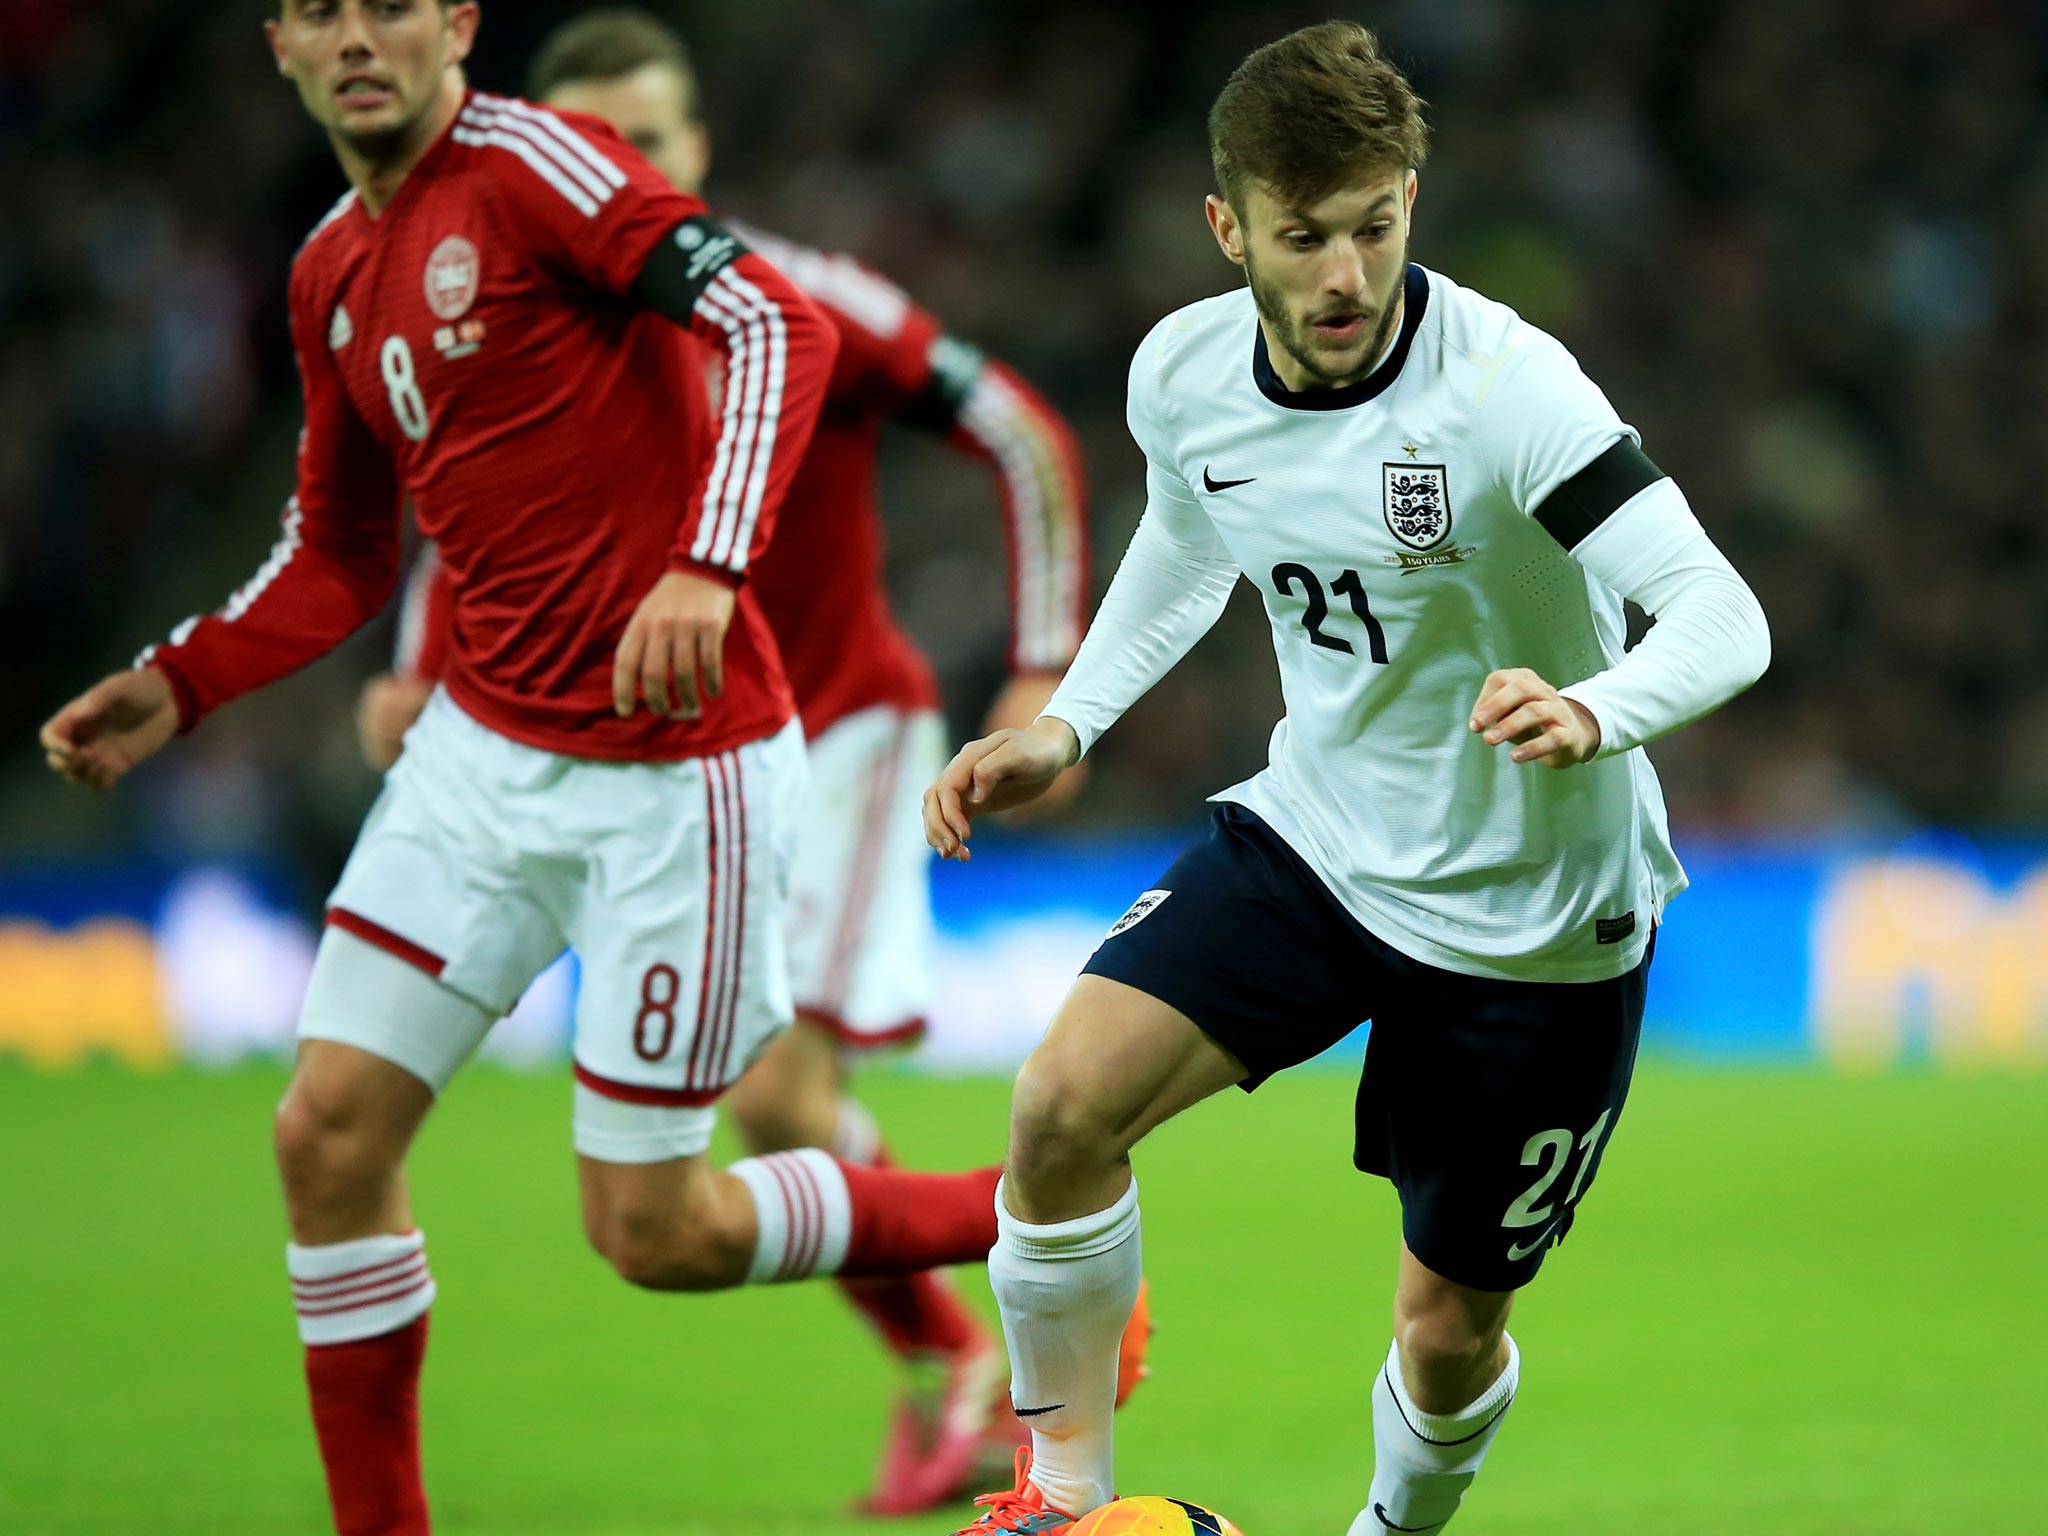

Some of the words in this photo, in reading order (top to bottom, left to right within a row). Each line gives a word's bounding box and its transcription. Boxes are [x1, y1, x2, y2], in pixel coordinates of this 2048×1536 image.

[381, 334, 429, 441] 8
[1406, 556, 1422, 565] 150
[1422, 554, 1451, 565] YEARS
[1271, 562, 1390, 665] 21
[633, 962, 680, 1062] 8
[1501, 1108, 1611, 1228] 21
